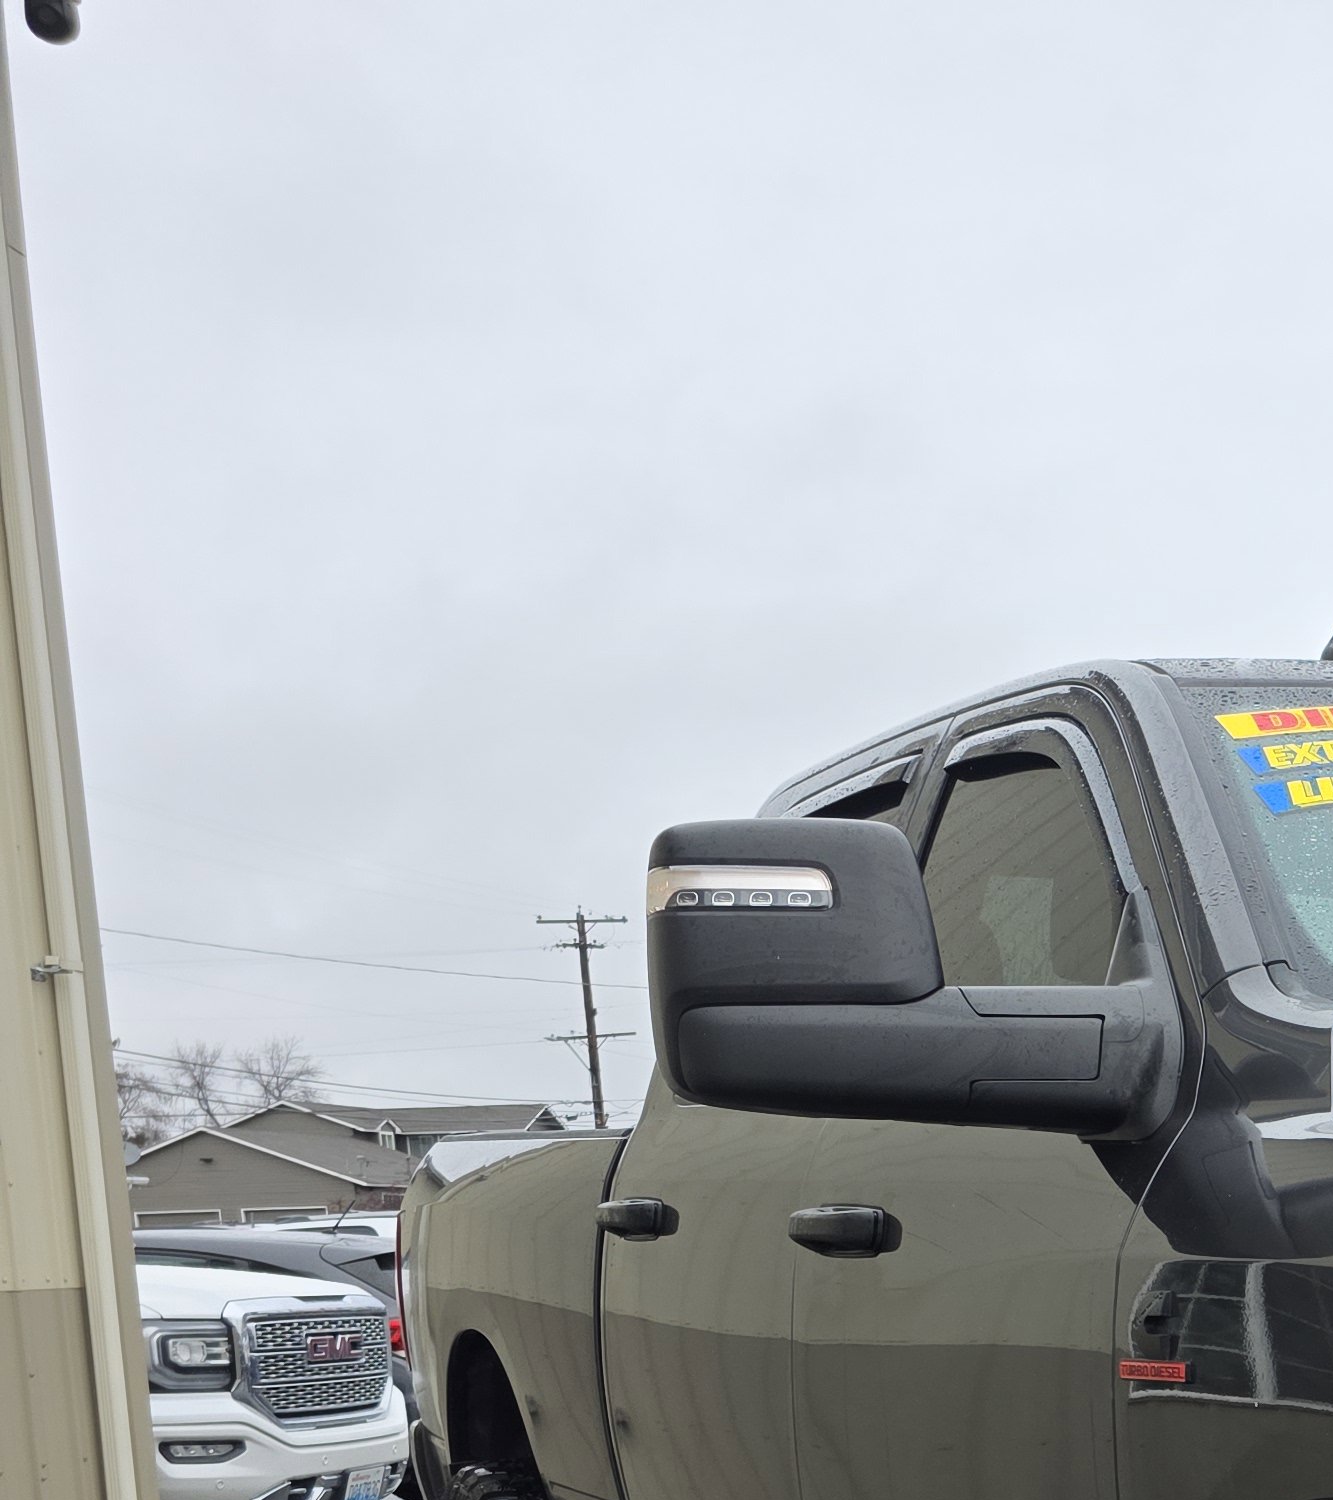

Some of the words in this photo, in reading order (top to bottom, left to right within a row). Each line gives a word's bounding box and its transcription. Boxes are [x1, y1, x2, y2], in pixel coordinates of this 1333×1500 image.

[306, 1333, 362, 1361] GMC
[1121, 1364, 1149, 1377] TURBO
[1150, 1365, 1184, 1379] DIESEL
